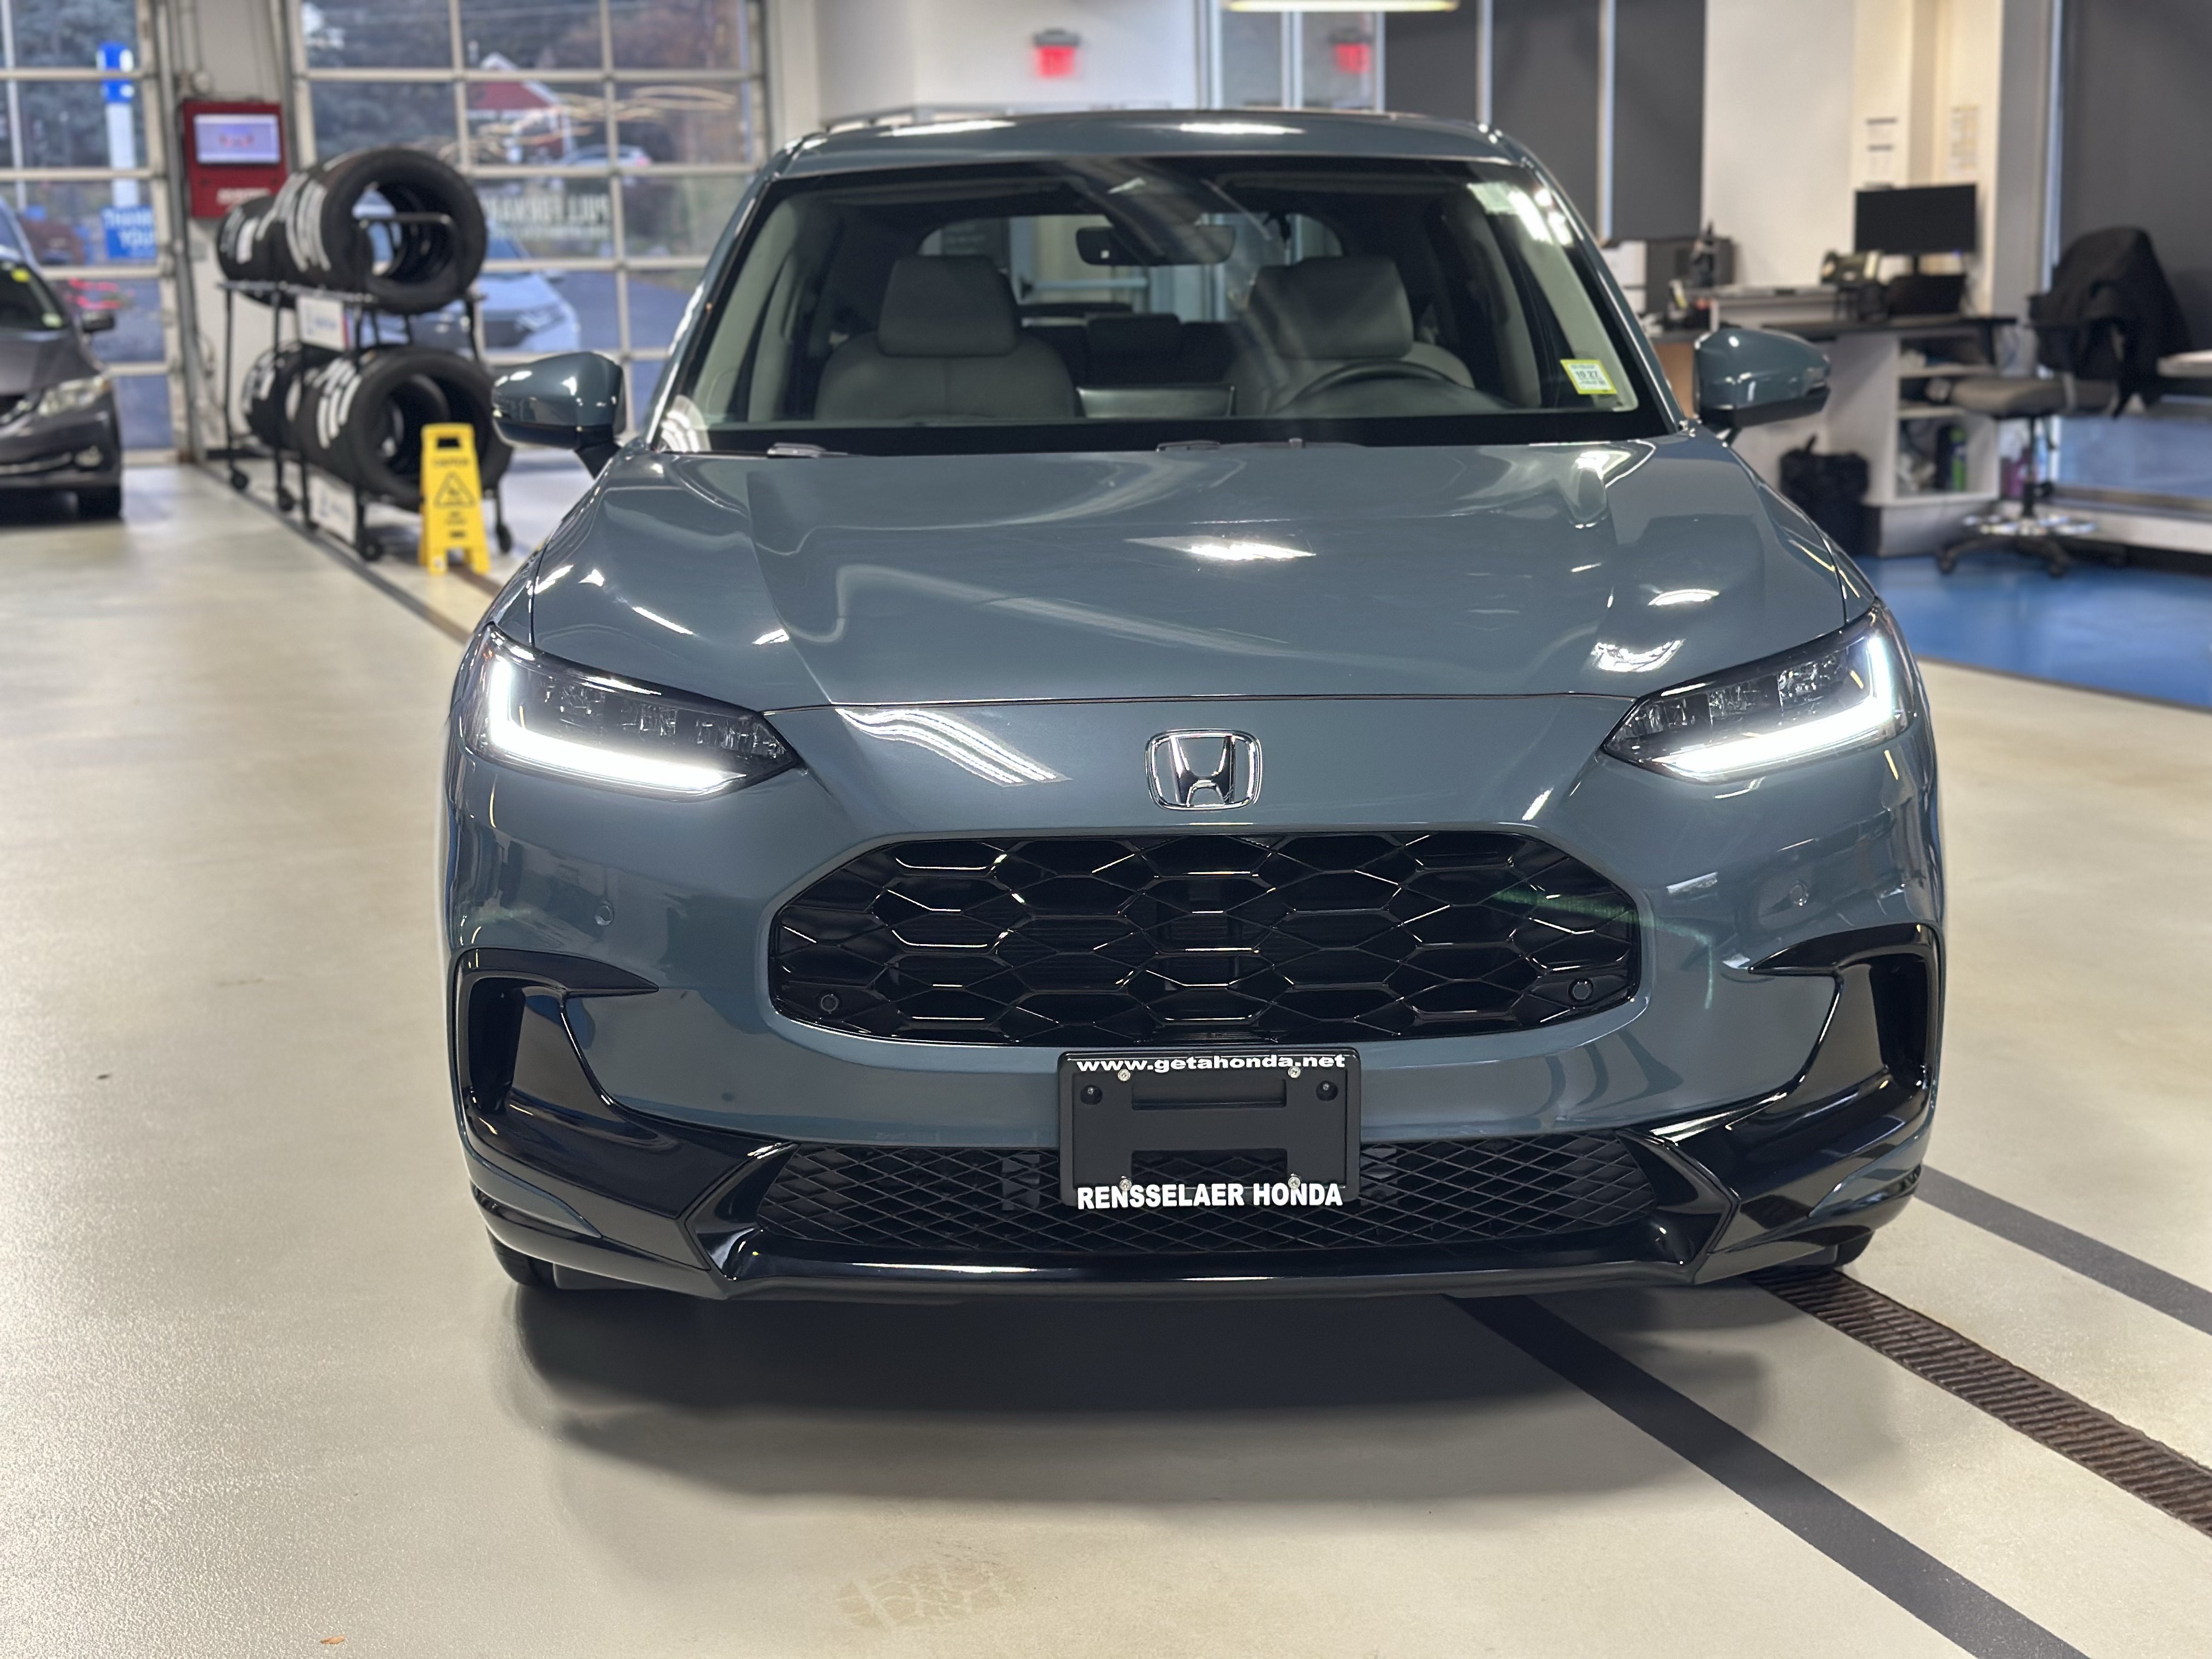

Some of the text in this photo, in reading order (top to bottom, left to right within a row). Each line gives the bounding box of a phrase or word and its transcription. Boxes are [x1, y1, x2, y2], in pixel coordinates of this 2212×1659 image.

[1076, 1054, 1345, 1073] www.getahonda.net
[1077, 1183, 1343, 1210] RENSSELAER HONDA
